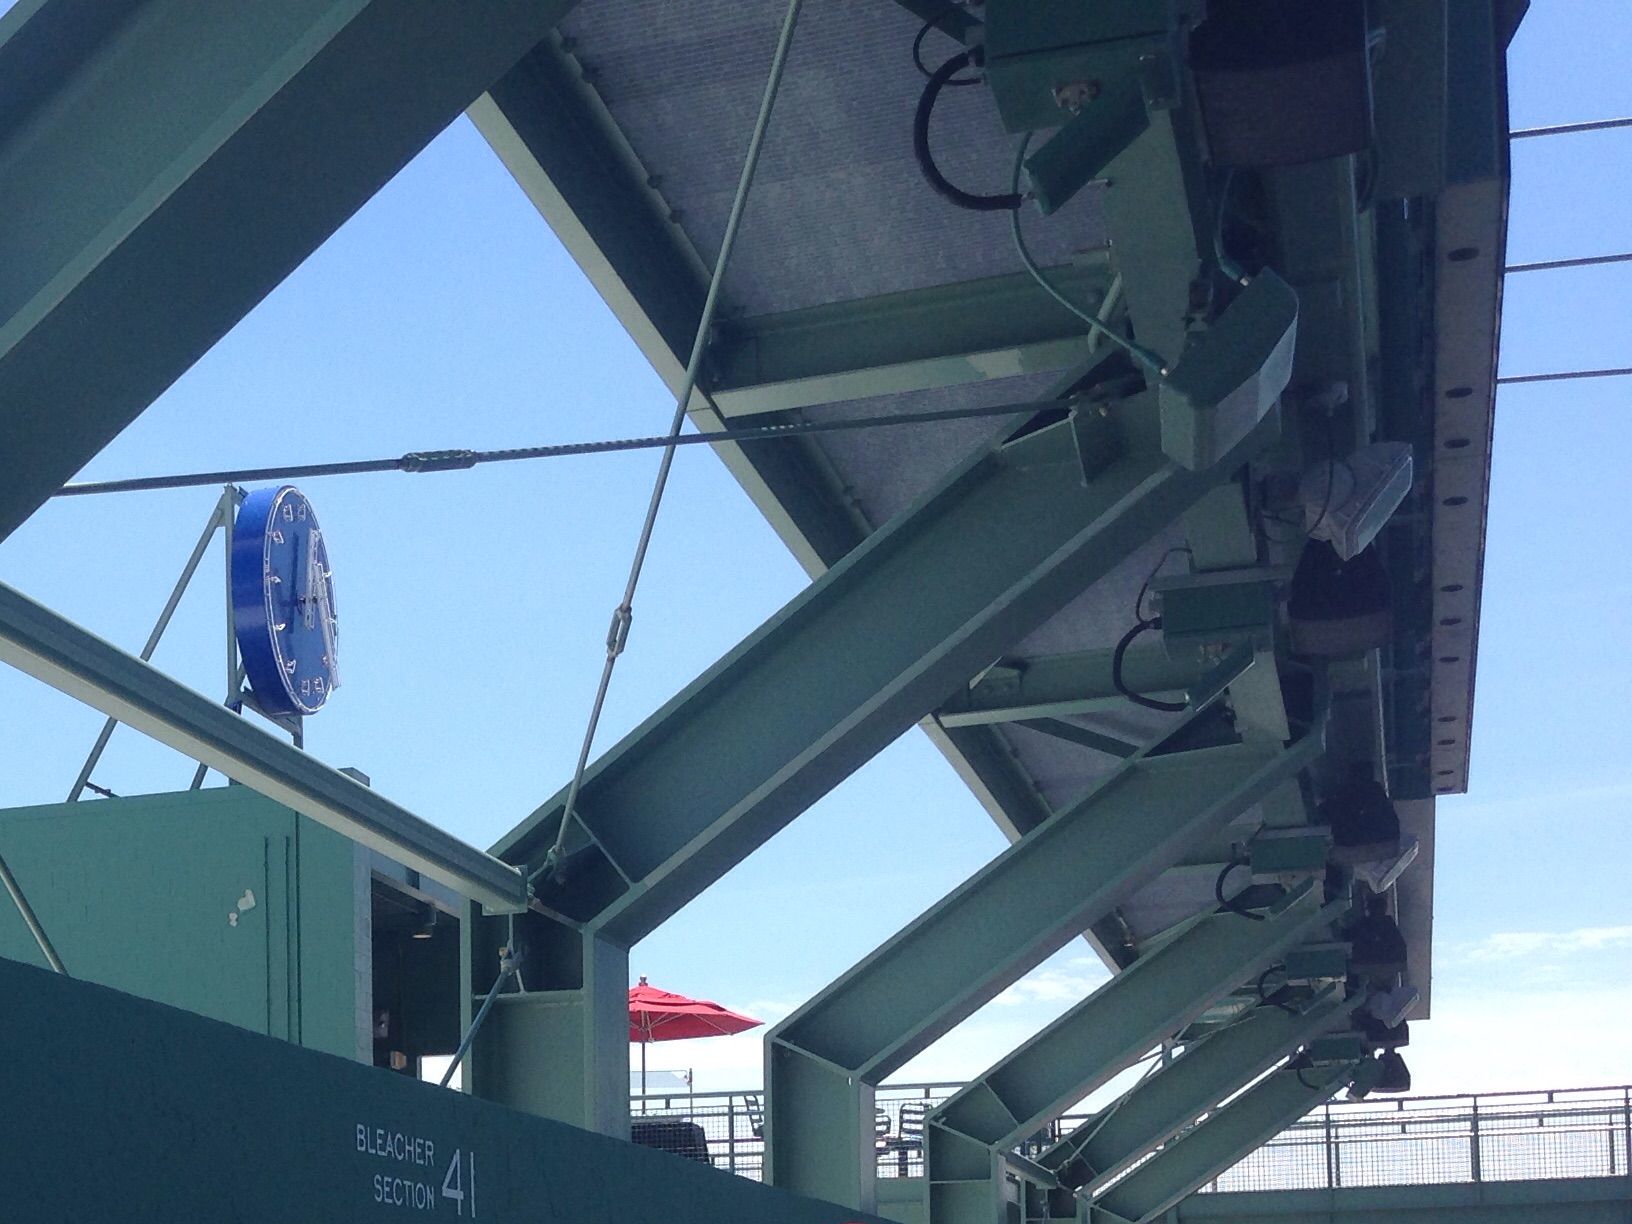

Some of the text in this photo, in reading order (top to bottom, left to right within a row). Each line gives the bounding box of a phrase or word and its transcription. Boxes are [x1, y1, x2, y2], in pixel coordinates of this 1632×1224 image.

[356, 1123, 434, 1167] BLEACHER
[373, 1174, 435, 1210] SECTION
[441, 1148, 476, 1218] 41
